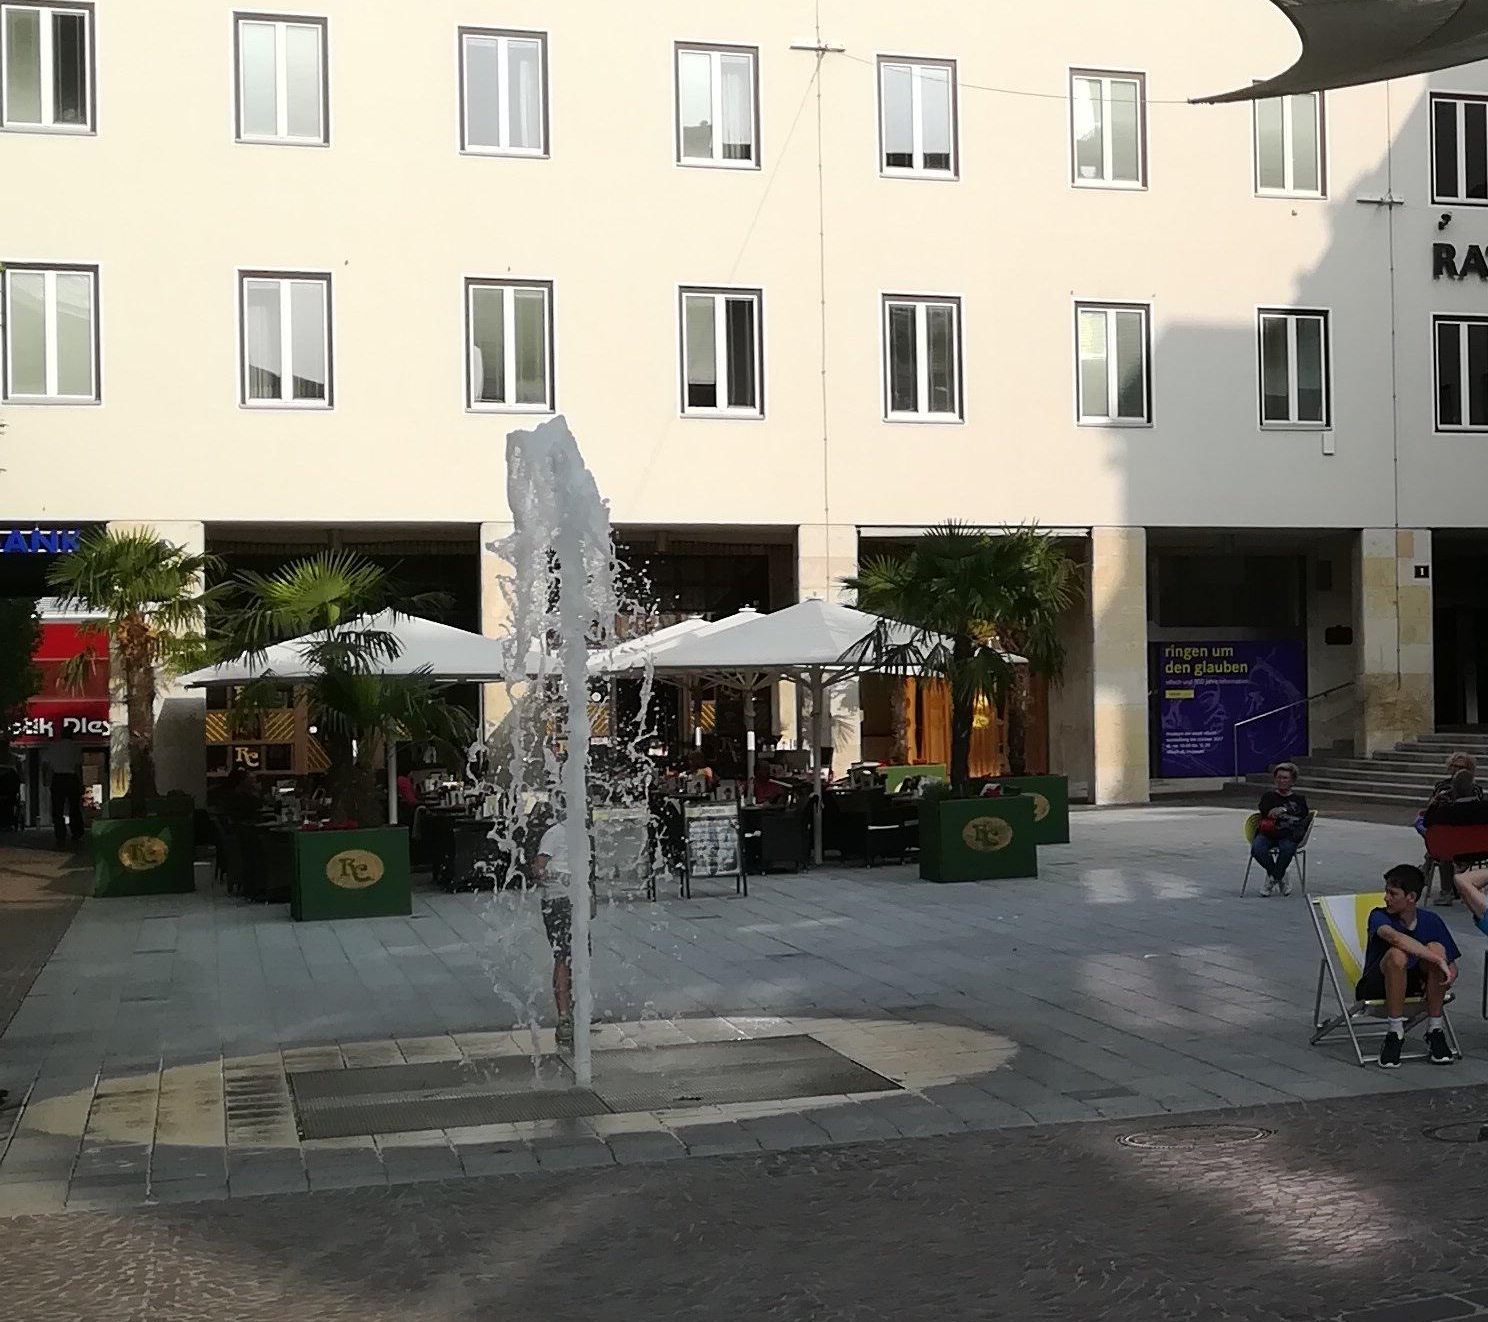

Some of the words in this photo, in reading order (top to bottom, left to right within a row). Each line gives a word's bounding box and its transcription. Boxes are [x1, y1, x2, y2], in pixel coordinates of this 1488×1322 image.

[1164, 644, 1208, 660] ringen
[1212, 646, 1234, 657] um
[1164, 660, 1191, 674] den
[1194, 660, 1249, 676] glauben
